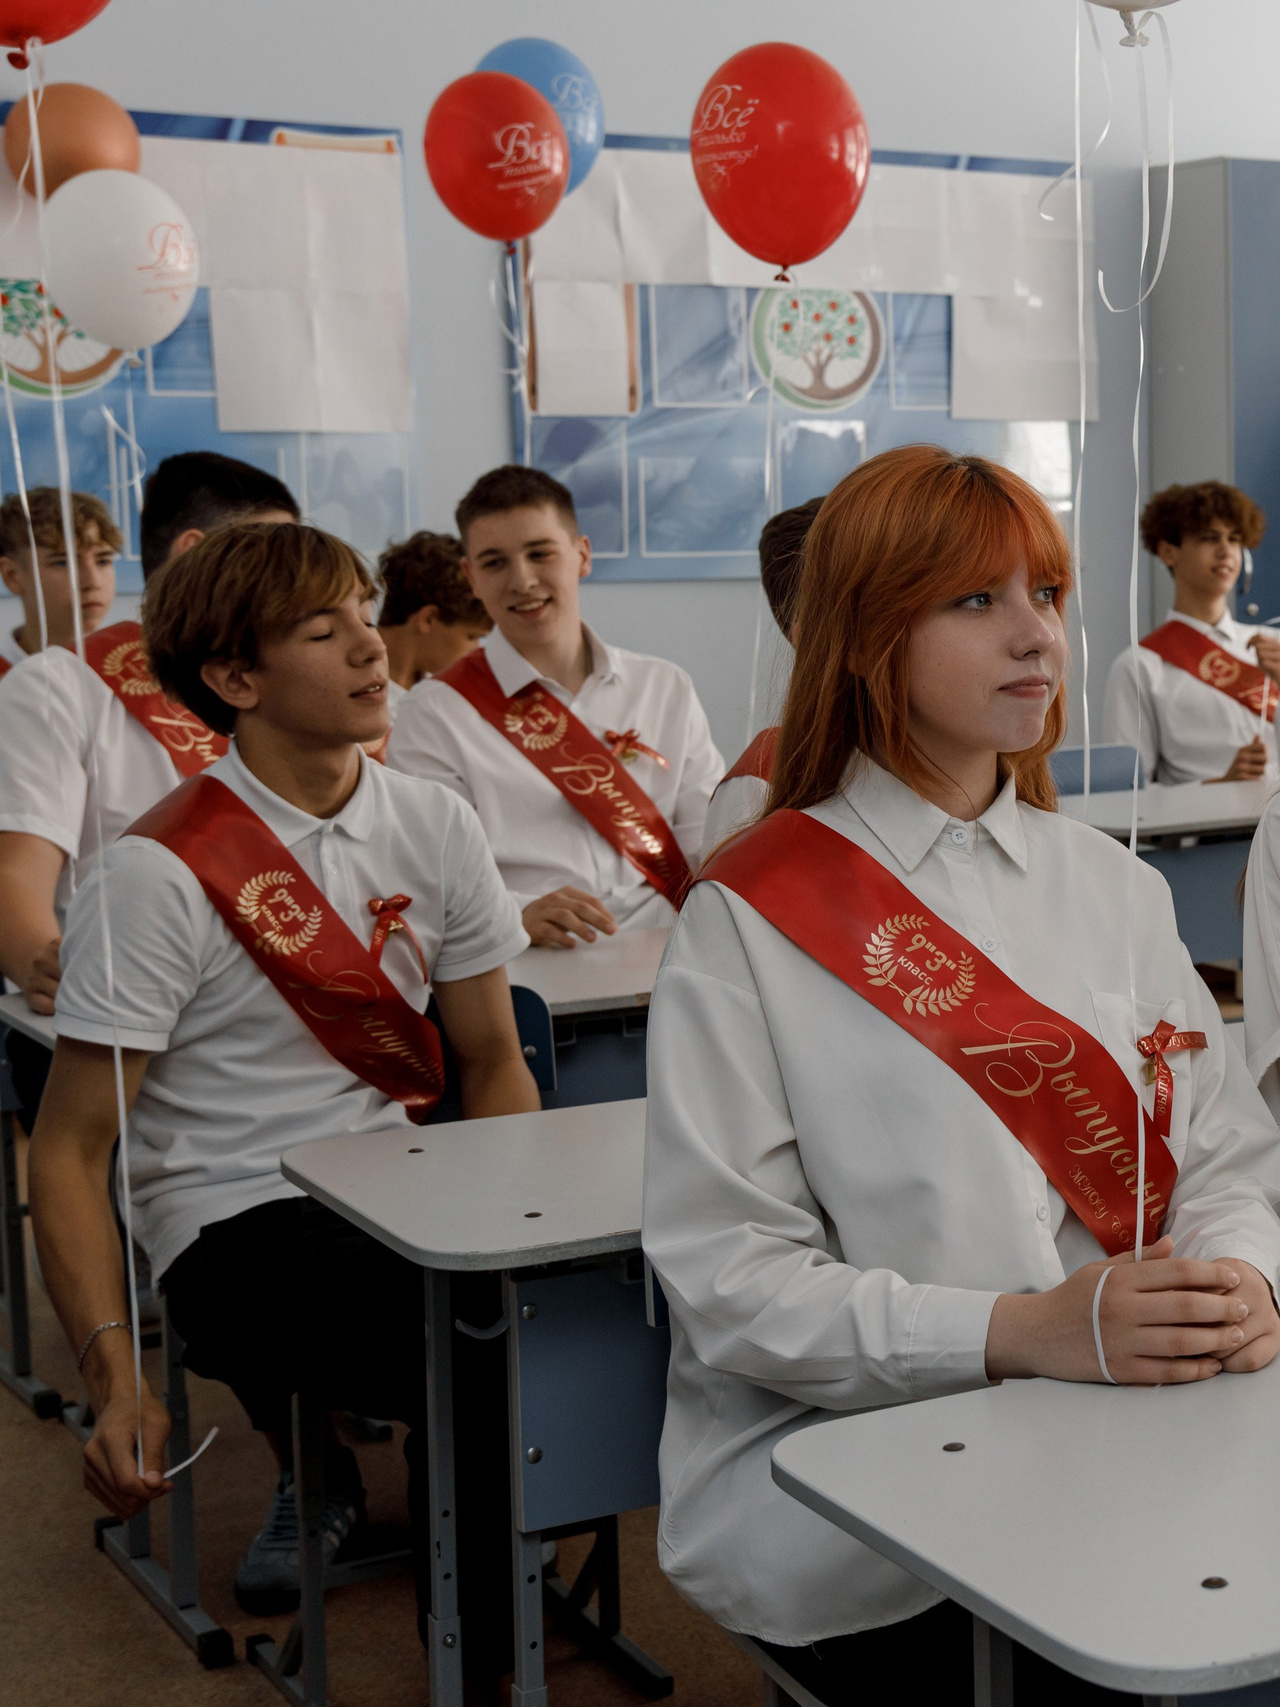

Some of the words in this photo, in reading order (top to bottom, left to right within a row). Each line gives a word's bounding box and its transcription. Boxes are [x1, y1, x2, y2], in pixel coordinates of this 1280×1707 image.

[692, 84, 760, 133] Всё
[260, 905, 284, 933] класс
[897, 955, 933, 985] класс
[1069, 1164, 1109, 1219] МАОУ
